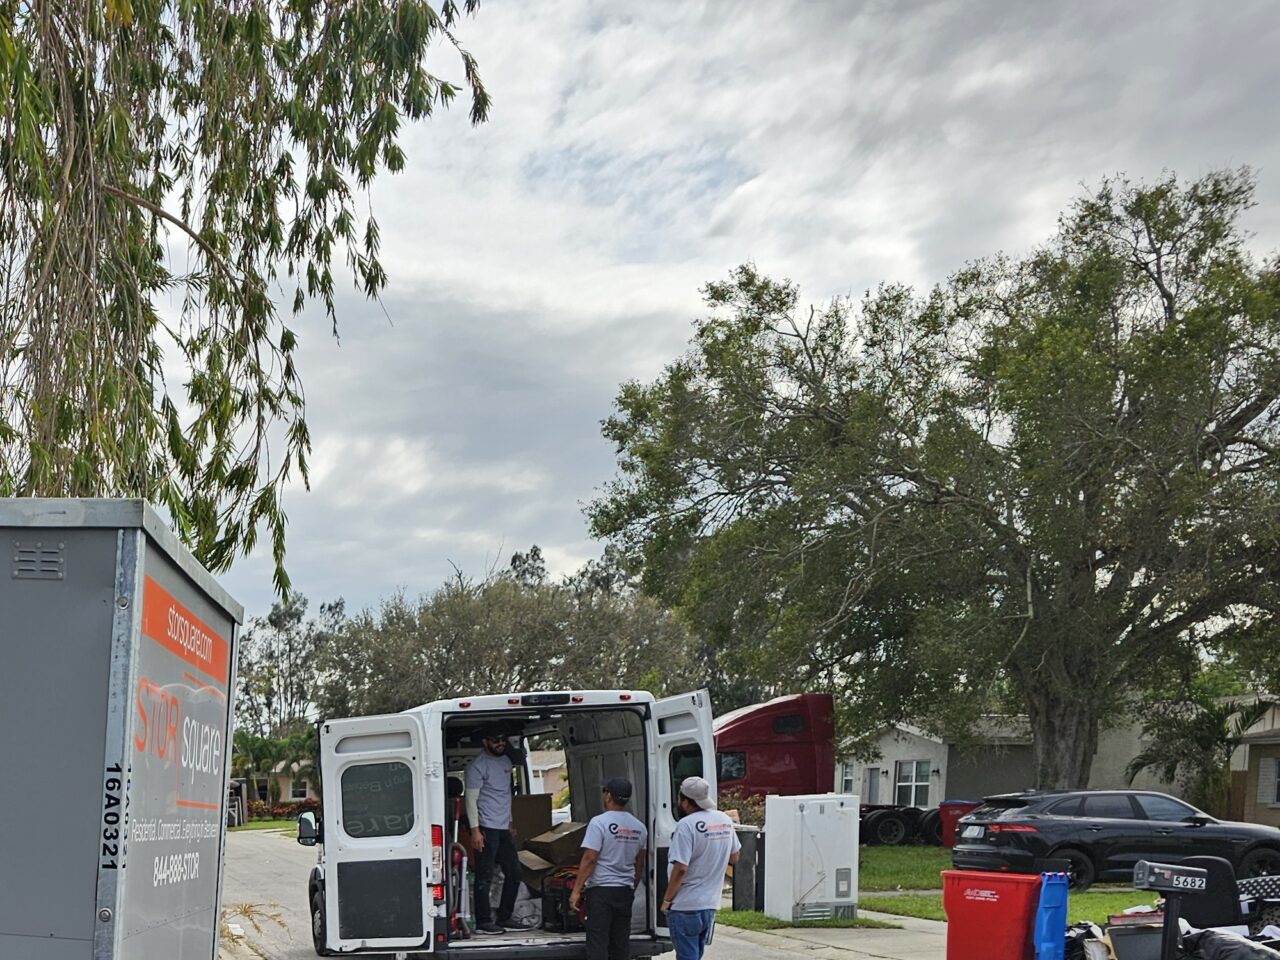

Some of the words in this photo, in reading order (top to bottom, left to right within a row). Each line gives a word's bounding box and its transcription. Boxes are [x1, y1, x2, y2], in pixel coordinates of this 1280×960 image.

[167, 604, 213, 664] storsquare.com
[134, 676, 178, 763] STOR
[181, 715, 221, 784] square
[102, 763, 122, 870] 16A0321
[153, 852, 199, 887] 844-888-STOR
[1174, 876, 1205, 889] 5682
